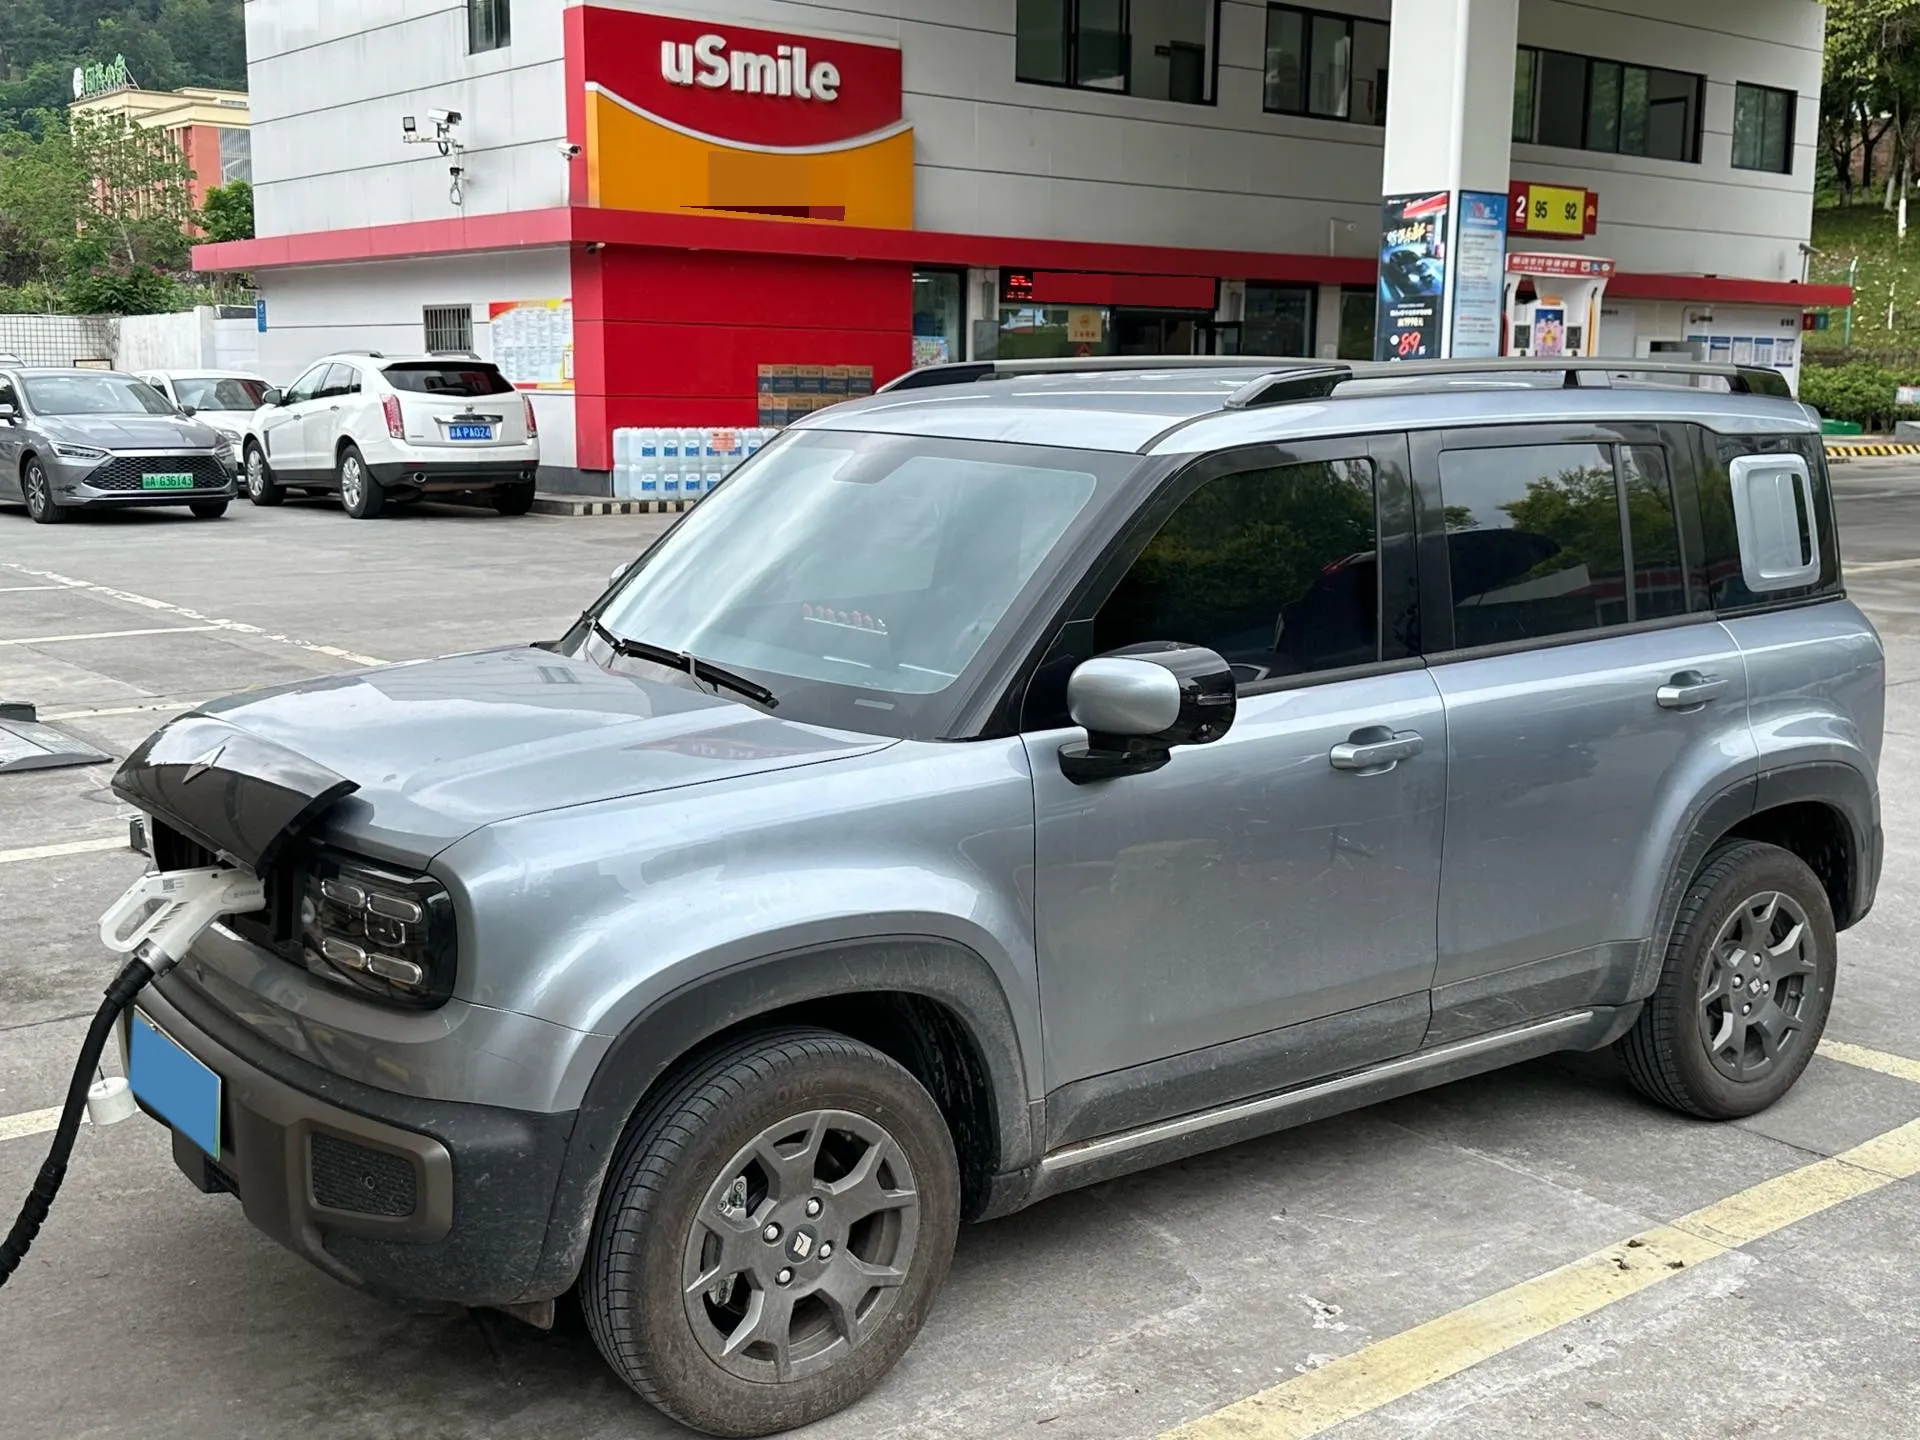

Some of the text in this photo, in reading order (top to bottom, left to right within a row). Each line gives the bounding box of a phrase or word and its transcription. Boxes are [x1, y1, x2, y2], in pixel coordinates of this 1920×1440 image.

[661, 34, 840, 101] uSmile
[1515, 195, 1526, 217] 2
[1535, 200, 1548, 218] 95
[1565, 202, 1577, 220] 92
